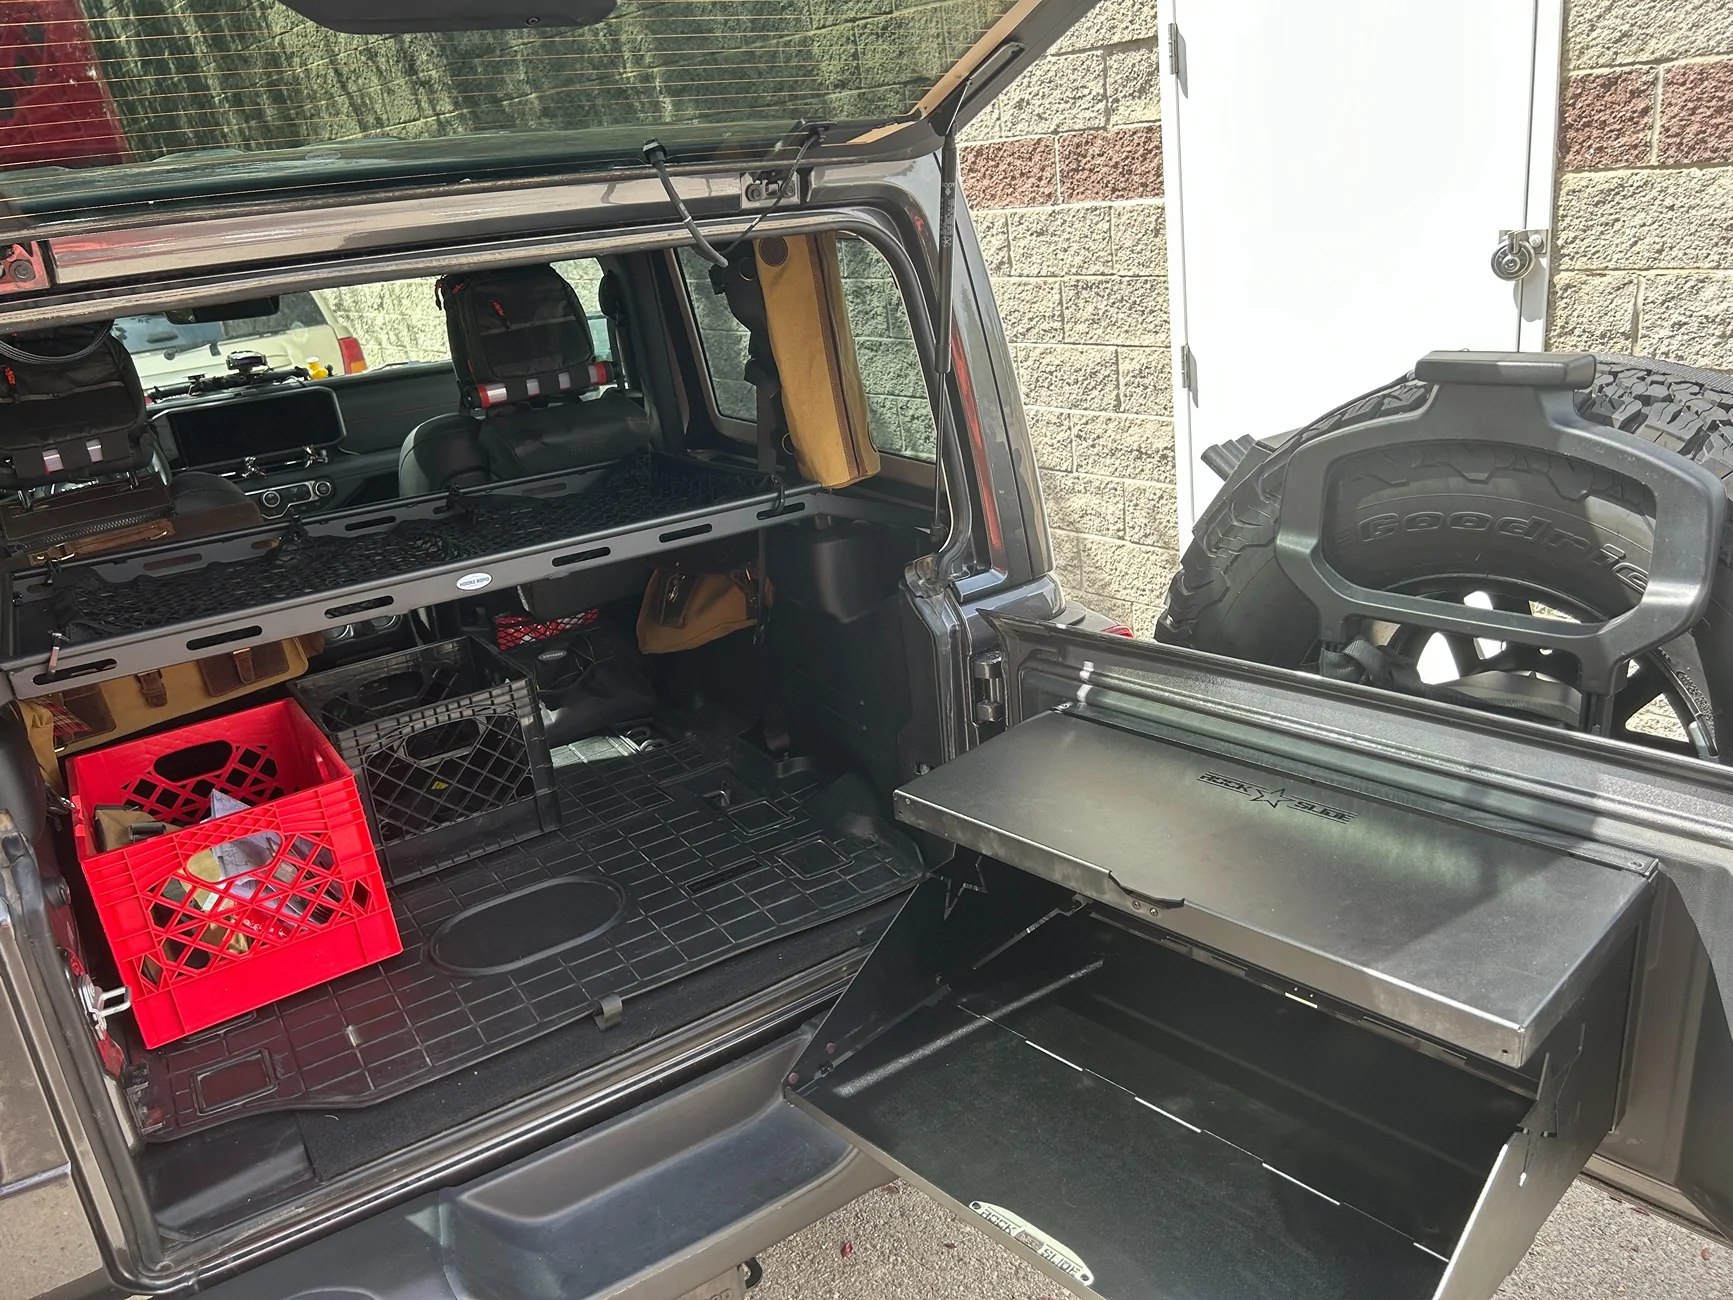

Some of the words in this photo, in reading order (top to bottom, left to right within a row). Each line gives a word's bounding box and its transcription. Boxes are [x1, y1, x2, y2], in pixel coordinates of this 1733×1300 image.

[1356, 510, 1650, 596] Goodric
[1200, 773, 1253, 793] ROCK
[1294, 801, 1356, 823] SLIDE
[980, 1208, 1018, 1237] ROCK
[1039, 1247, 1081, 1279] SLIDE
